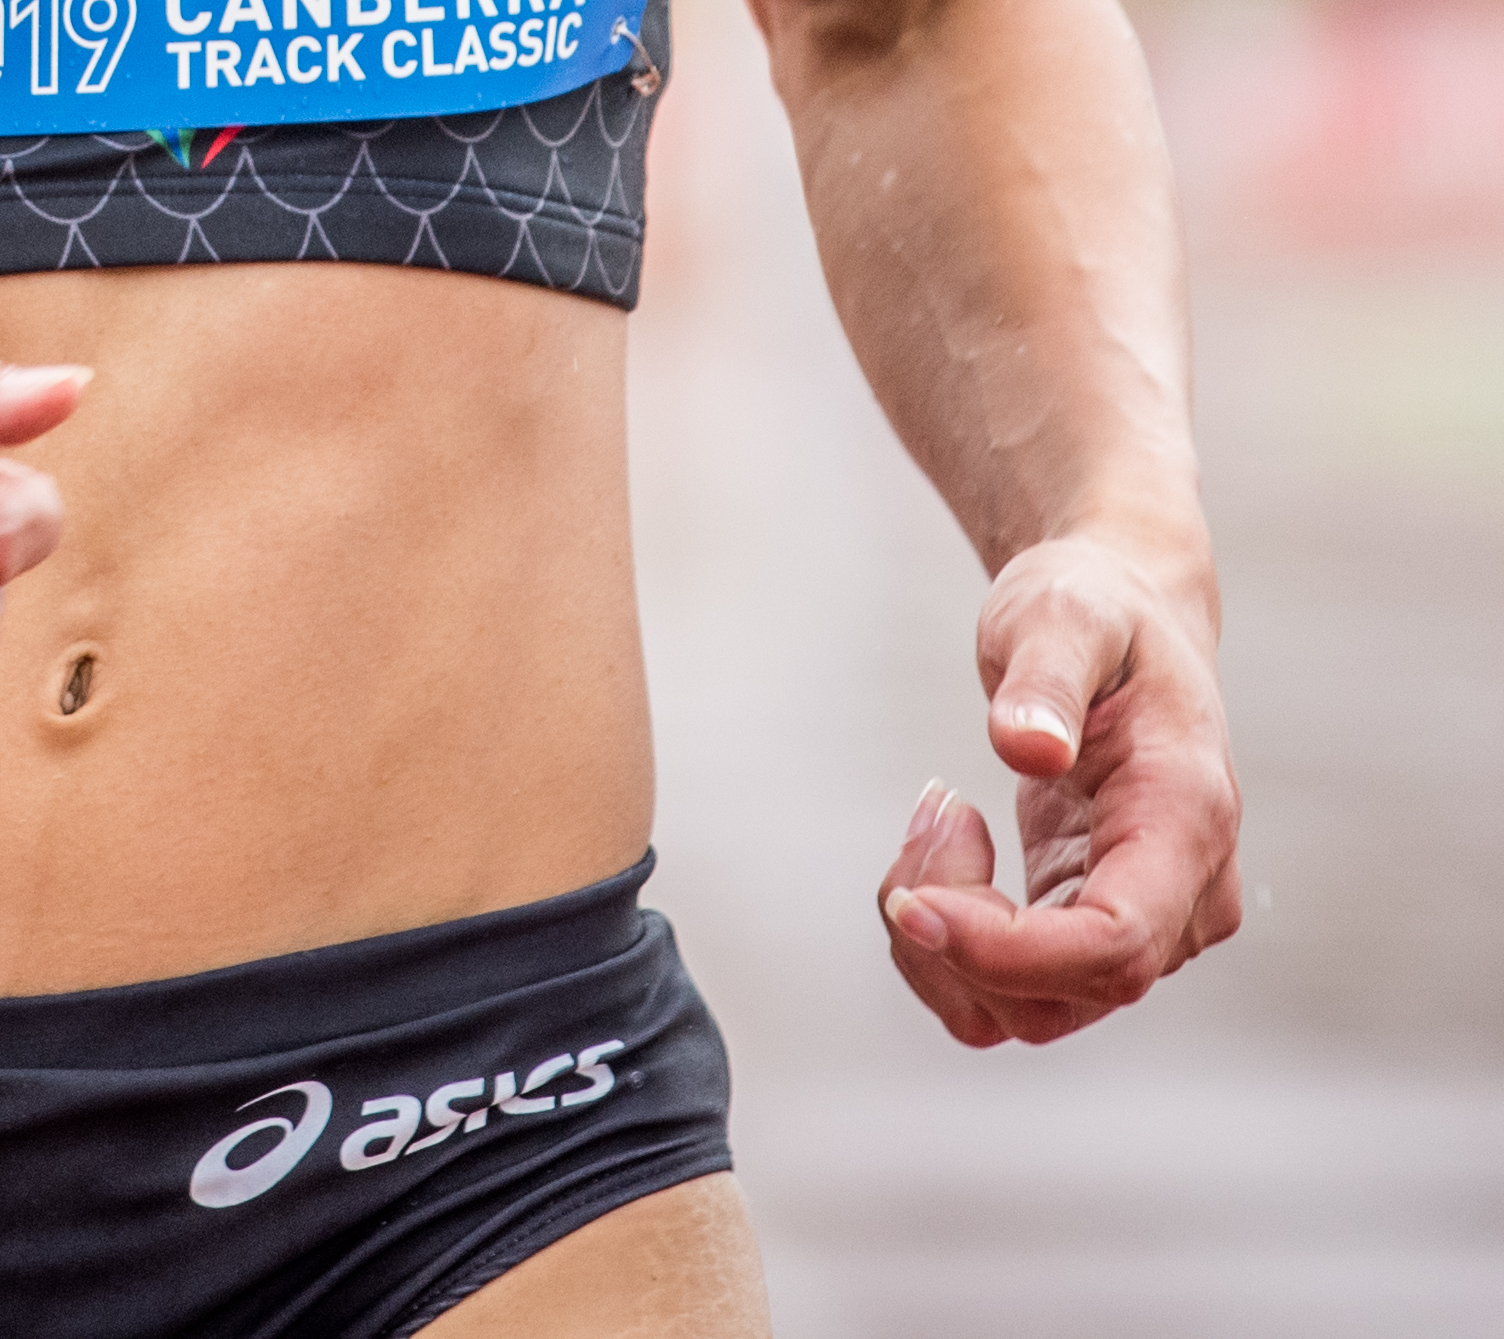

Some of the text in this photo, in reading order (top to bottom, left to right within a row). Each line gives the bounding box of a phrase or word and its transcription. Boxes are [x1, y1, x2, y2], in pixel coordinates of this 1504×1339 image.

[165, 13, 584, 91] TRACK CLASSIC
[339, 1038, 626, 1172] asics
